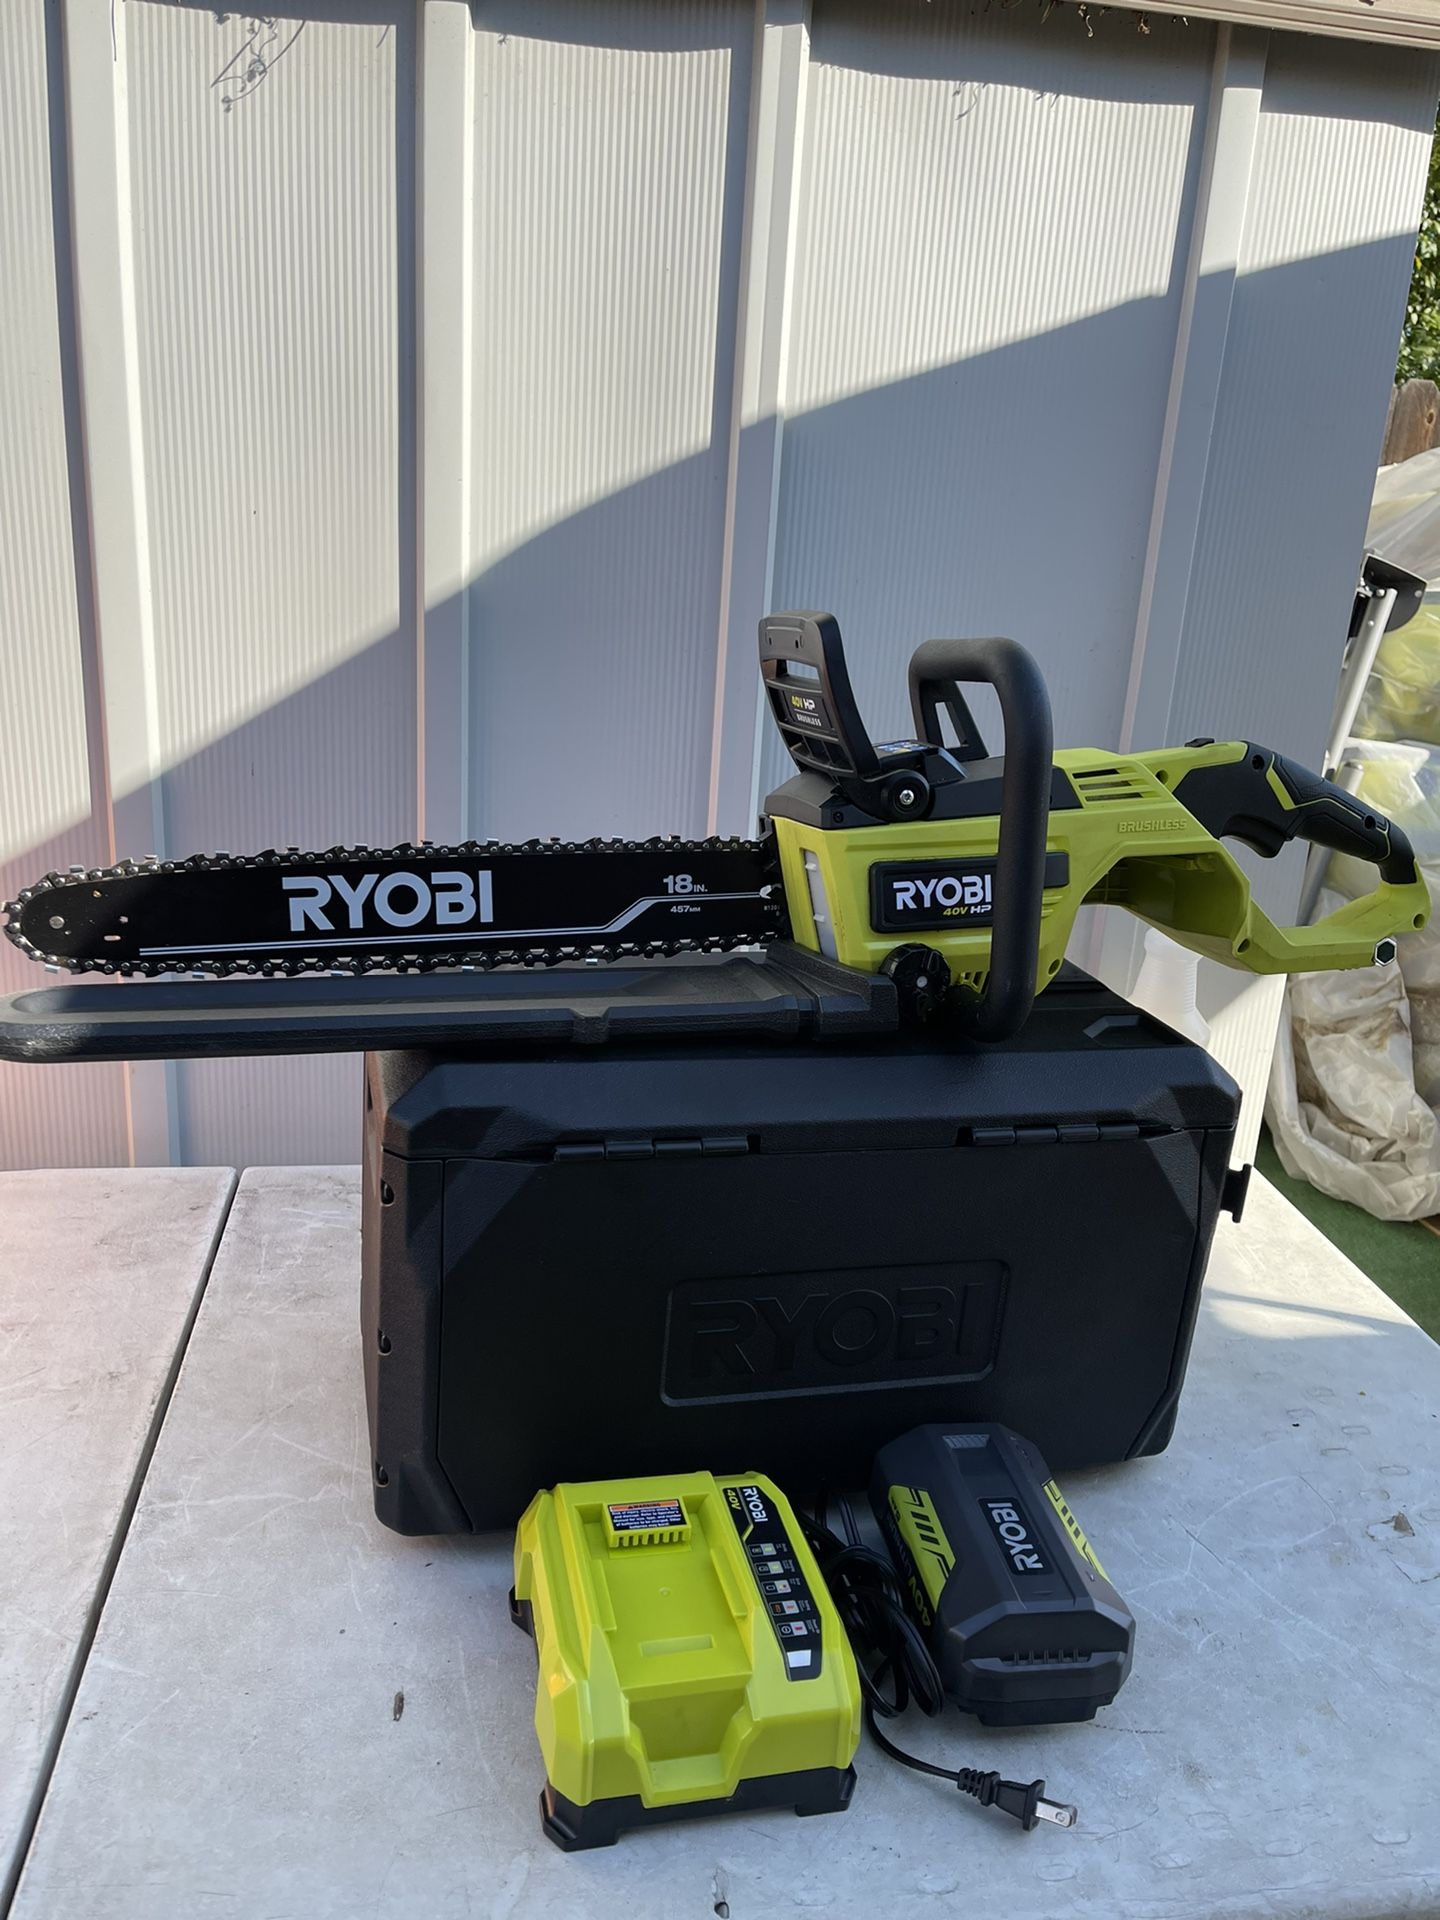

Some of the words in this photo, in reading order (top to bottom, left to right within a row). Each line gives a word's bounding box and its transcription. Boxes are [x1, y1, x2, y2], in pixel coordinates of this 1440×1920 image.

[791, 695, 803, 708] 40V
[803, 697, 816, 710] HP
[1118, 818, 1188, 833] BRUSHLESS
[281, 870, 494, 932] RYOBI
[892, 874, 993, 911] RYOBI
[942, 906, 968, 916] 40V
[970, 904, 993, 914] HP
[689, 1283, 984, 1378] RYOBI
[726, 1489, 742, 1511] 40V
[742, 1487, 769, 1523] RYOBI
[987, 1503, 1044, 1571] RYOBI
[908, 1576, 931, 1627] 40V
